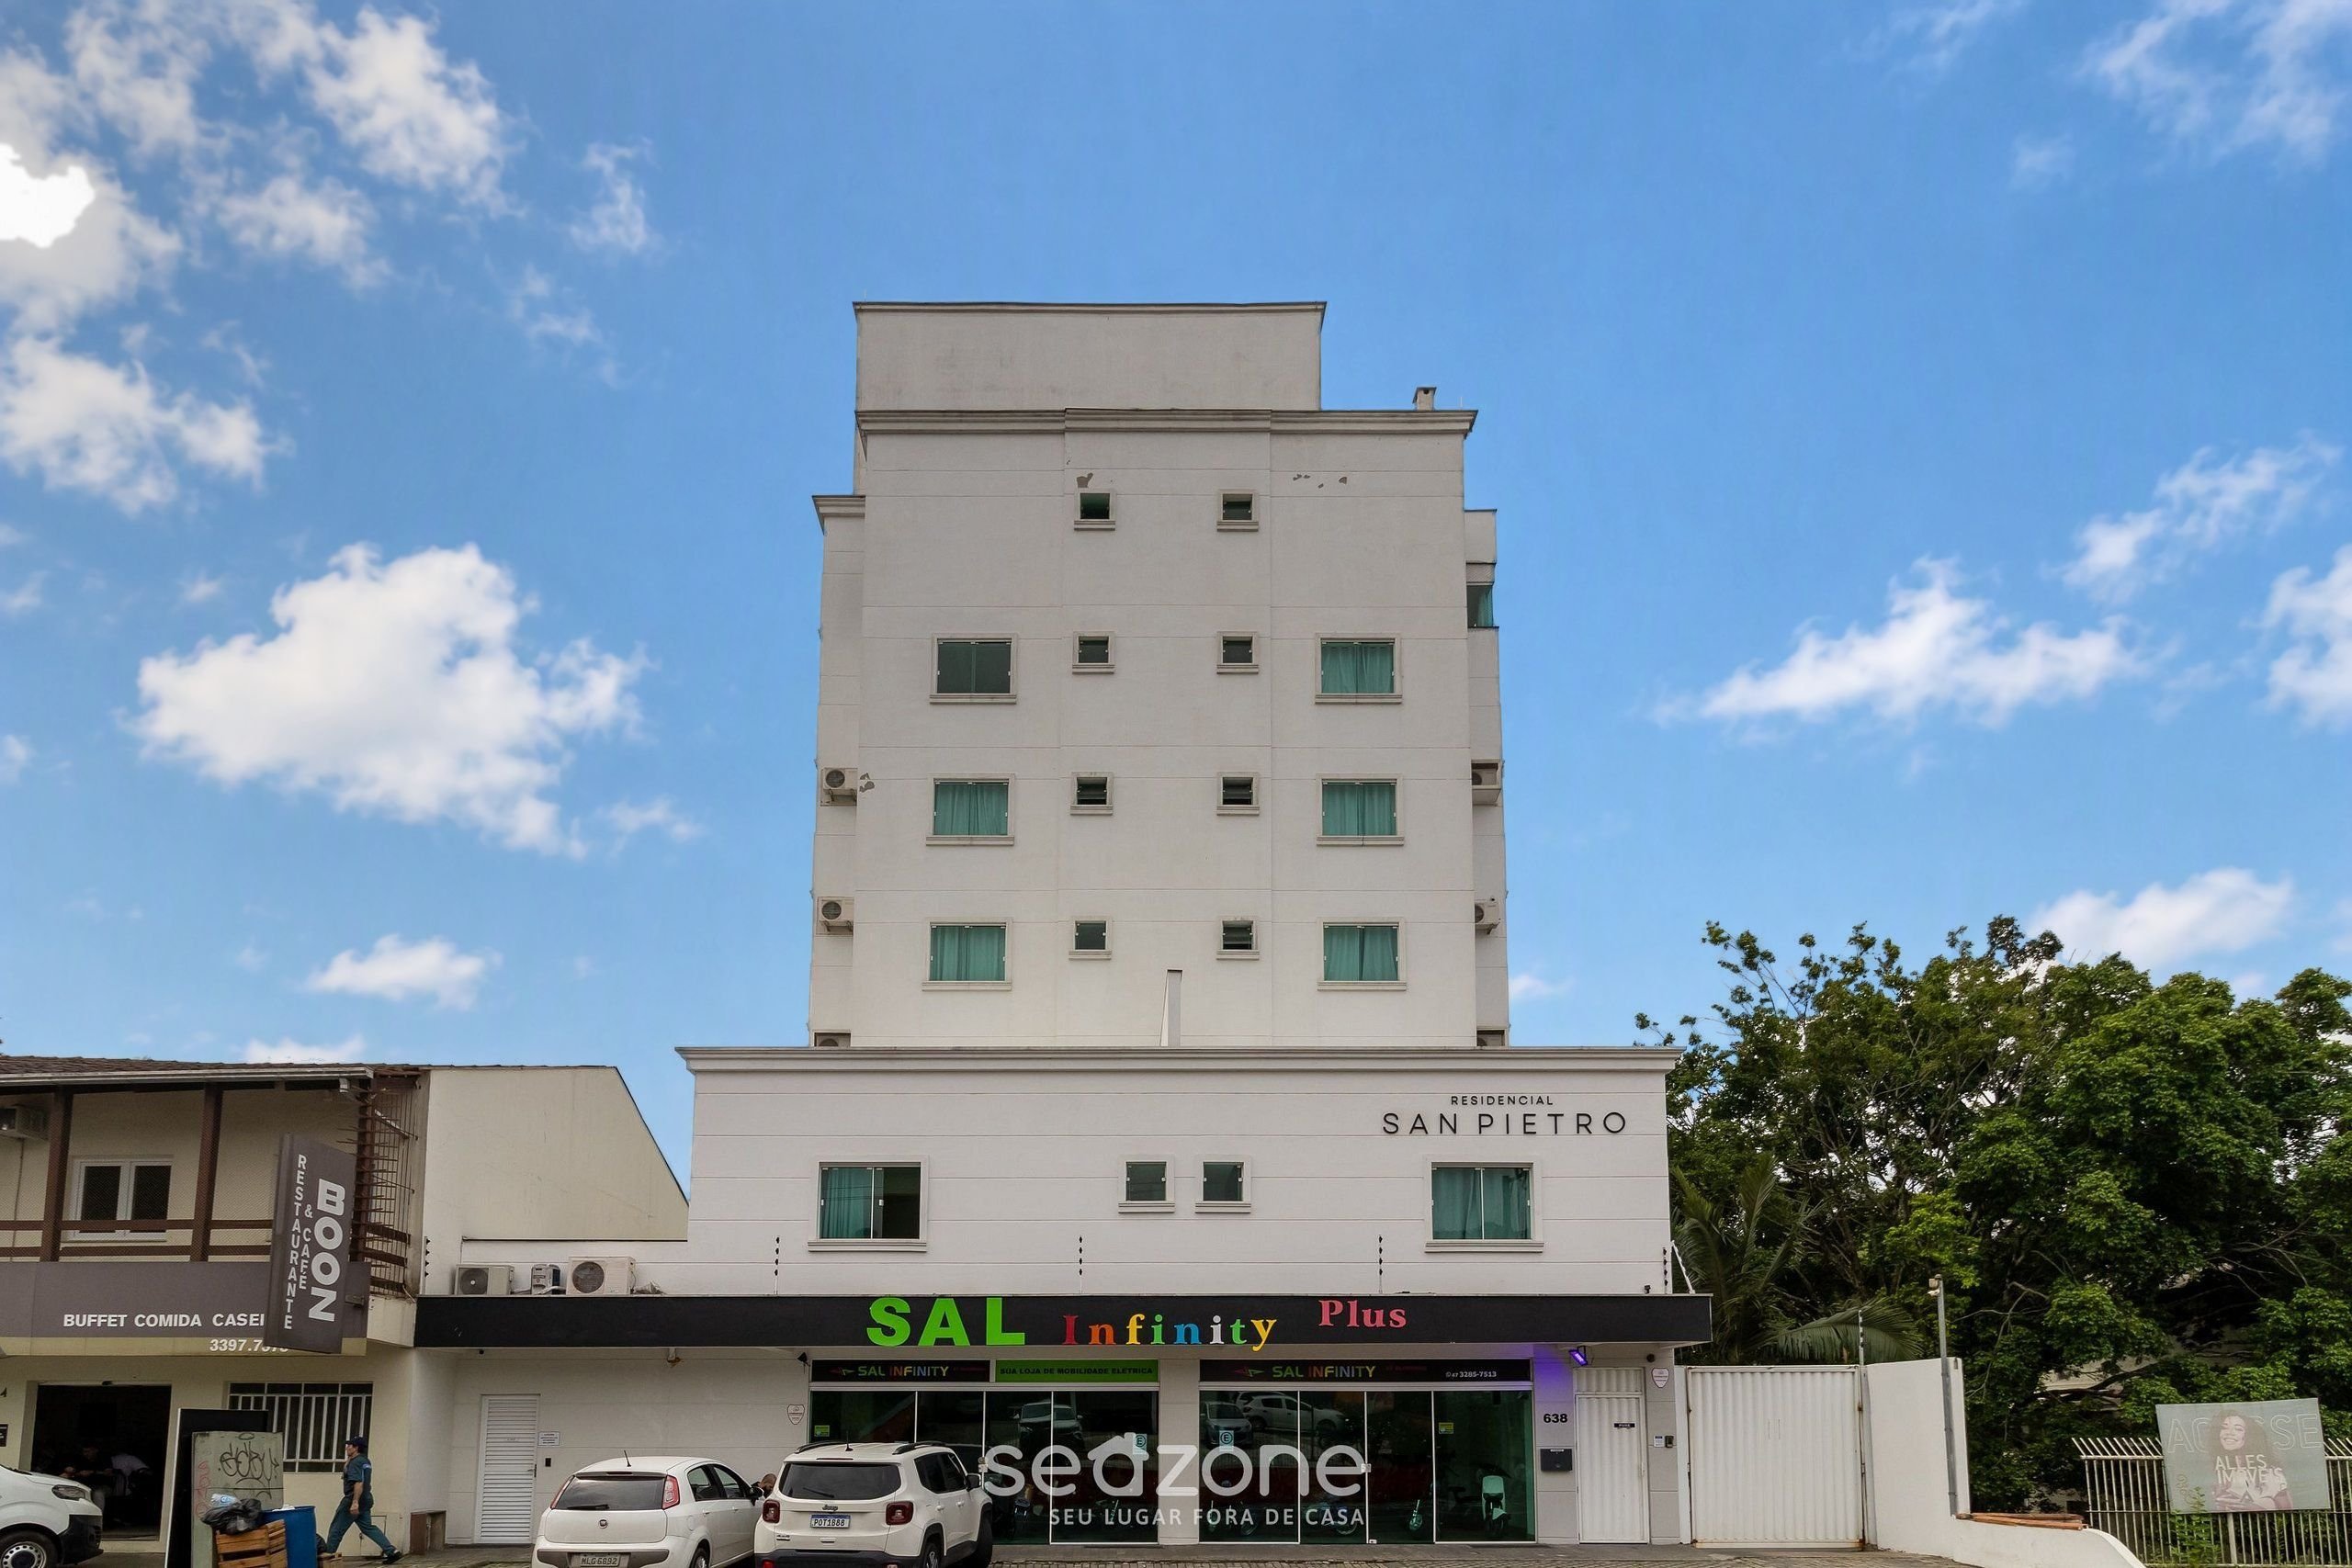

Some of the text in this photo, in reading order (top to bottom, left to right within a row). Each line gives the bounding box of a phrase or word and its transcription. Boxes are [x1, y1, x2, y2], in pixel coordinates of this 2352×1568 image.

[1451, 1096, 1553, 1105] RESIDENCIAL
[1383, 1111, 1626, 1134] SAN PIETRO
[304, 1204, 313, 1218] &
[284, 1154, 307, 1330] RESTAURANTE
[308, 1178, 345, 1322] BOOZ
[63, 1313, 265, 1327] BUFFET COMIDA CASEI
[865, 1296, 1406, 1352] SAL Infinity Plus
[858, 1366, 885, 1376] SAL
[889, 1366, 949, 1376] INFINITY
[1272, 1366, 1304, 1377] SAL
[1308, 1366, 1375, 1377] INFINITY
[1544, 1413, 1567, 1424] 638
[2215, 1454, 2267, 1471] ALLES
